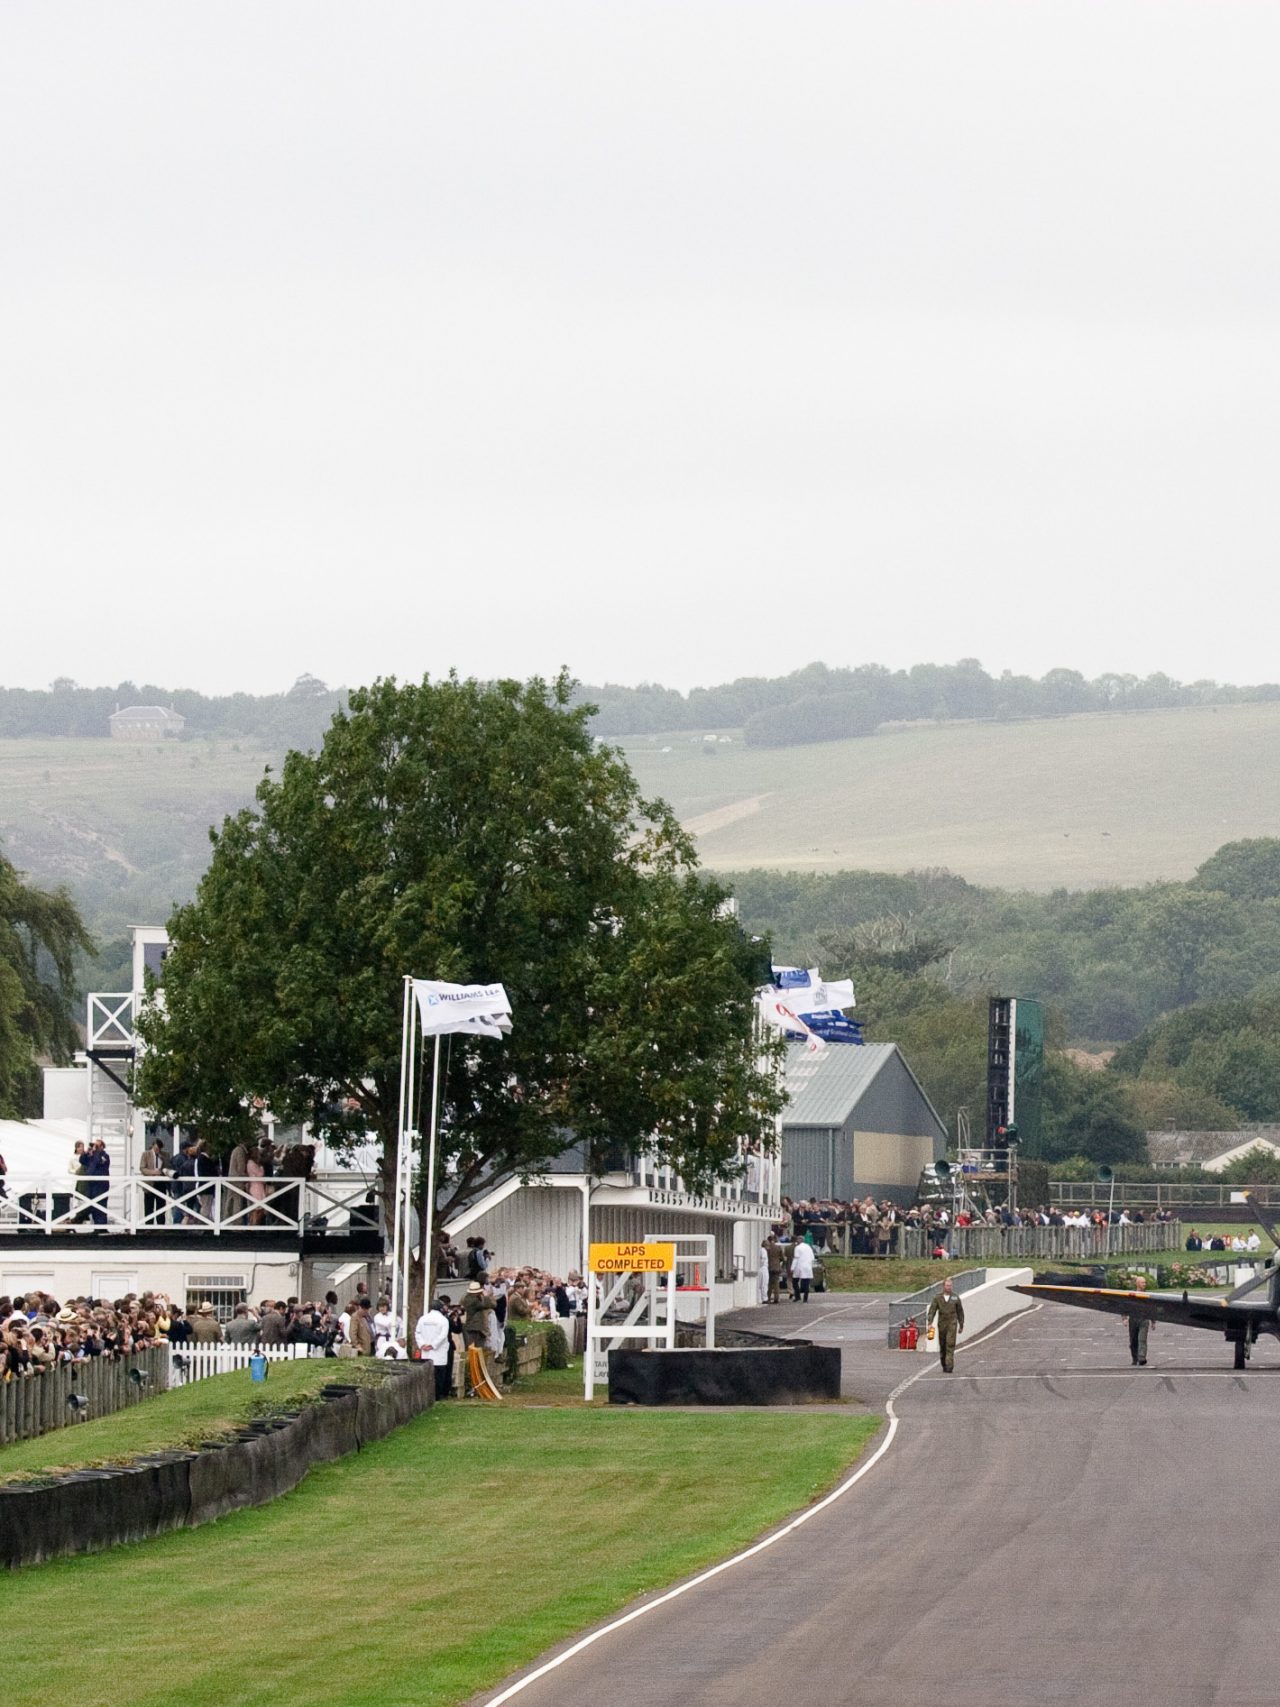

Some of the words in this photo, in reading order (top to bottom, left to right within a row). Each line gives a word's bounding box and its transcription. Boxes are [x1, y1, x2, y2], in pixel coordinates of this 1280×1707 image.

[438, 990, 483, 1001] WILLIAMS
[617, 1246, 646, 1256] LAPS
[597, 1259, 665, 1269] COMPLETED
